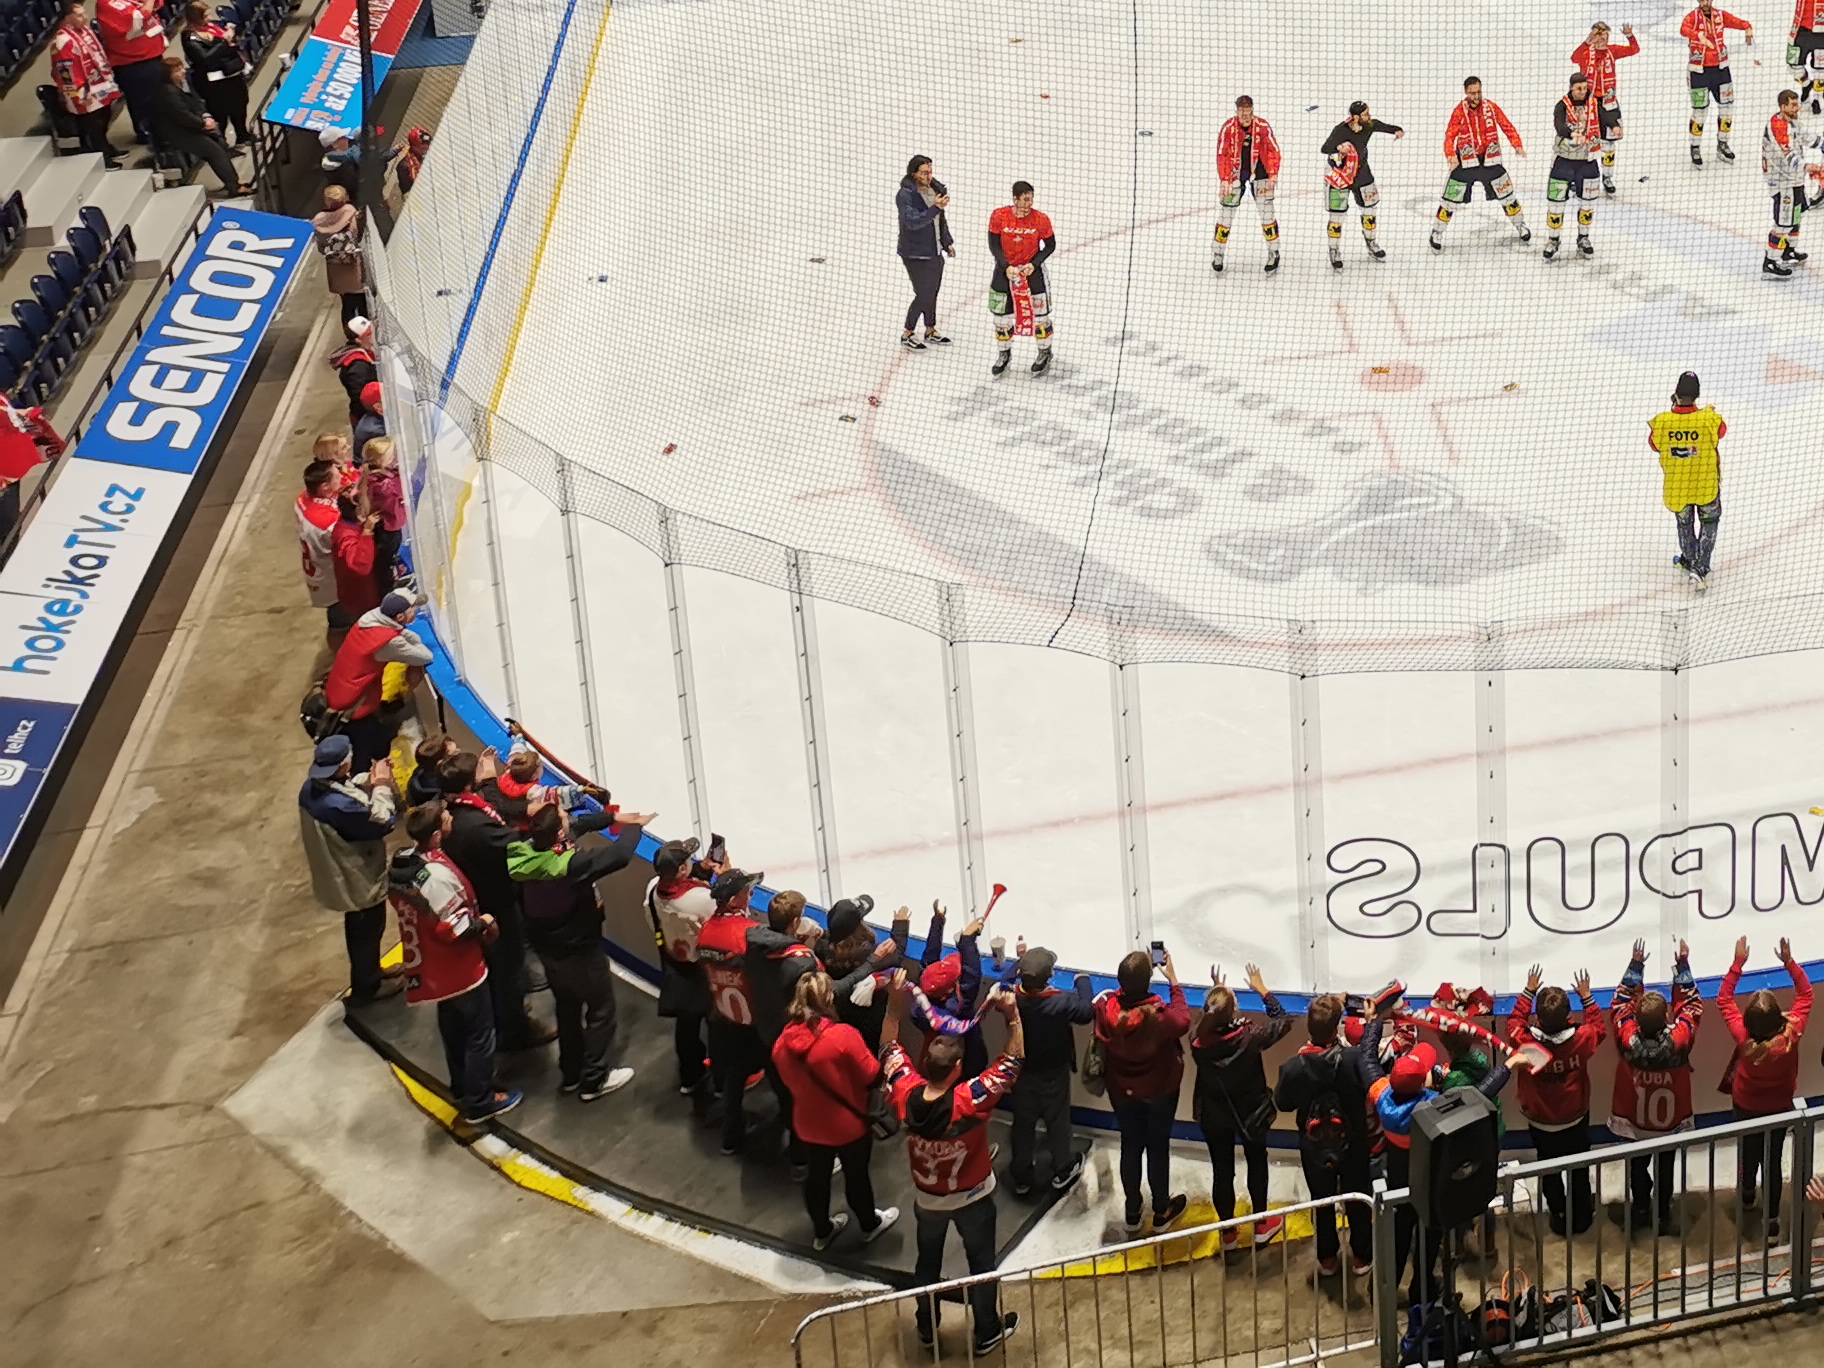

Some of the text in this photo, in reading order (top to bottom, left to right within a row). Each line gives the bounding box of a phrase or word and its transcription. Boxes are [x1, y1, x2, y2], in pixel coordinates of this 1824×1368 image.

[106, 227, 296, 451] SENCOR
[1667, 430, 1699, 442] FOTO
[0, 483, 146, 677] hokejkaTV.cz
[1635, 1087, 1677, 1130] 10
